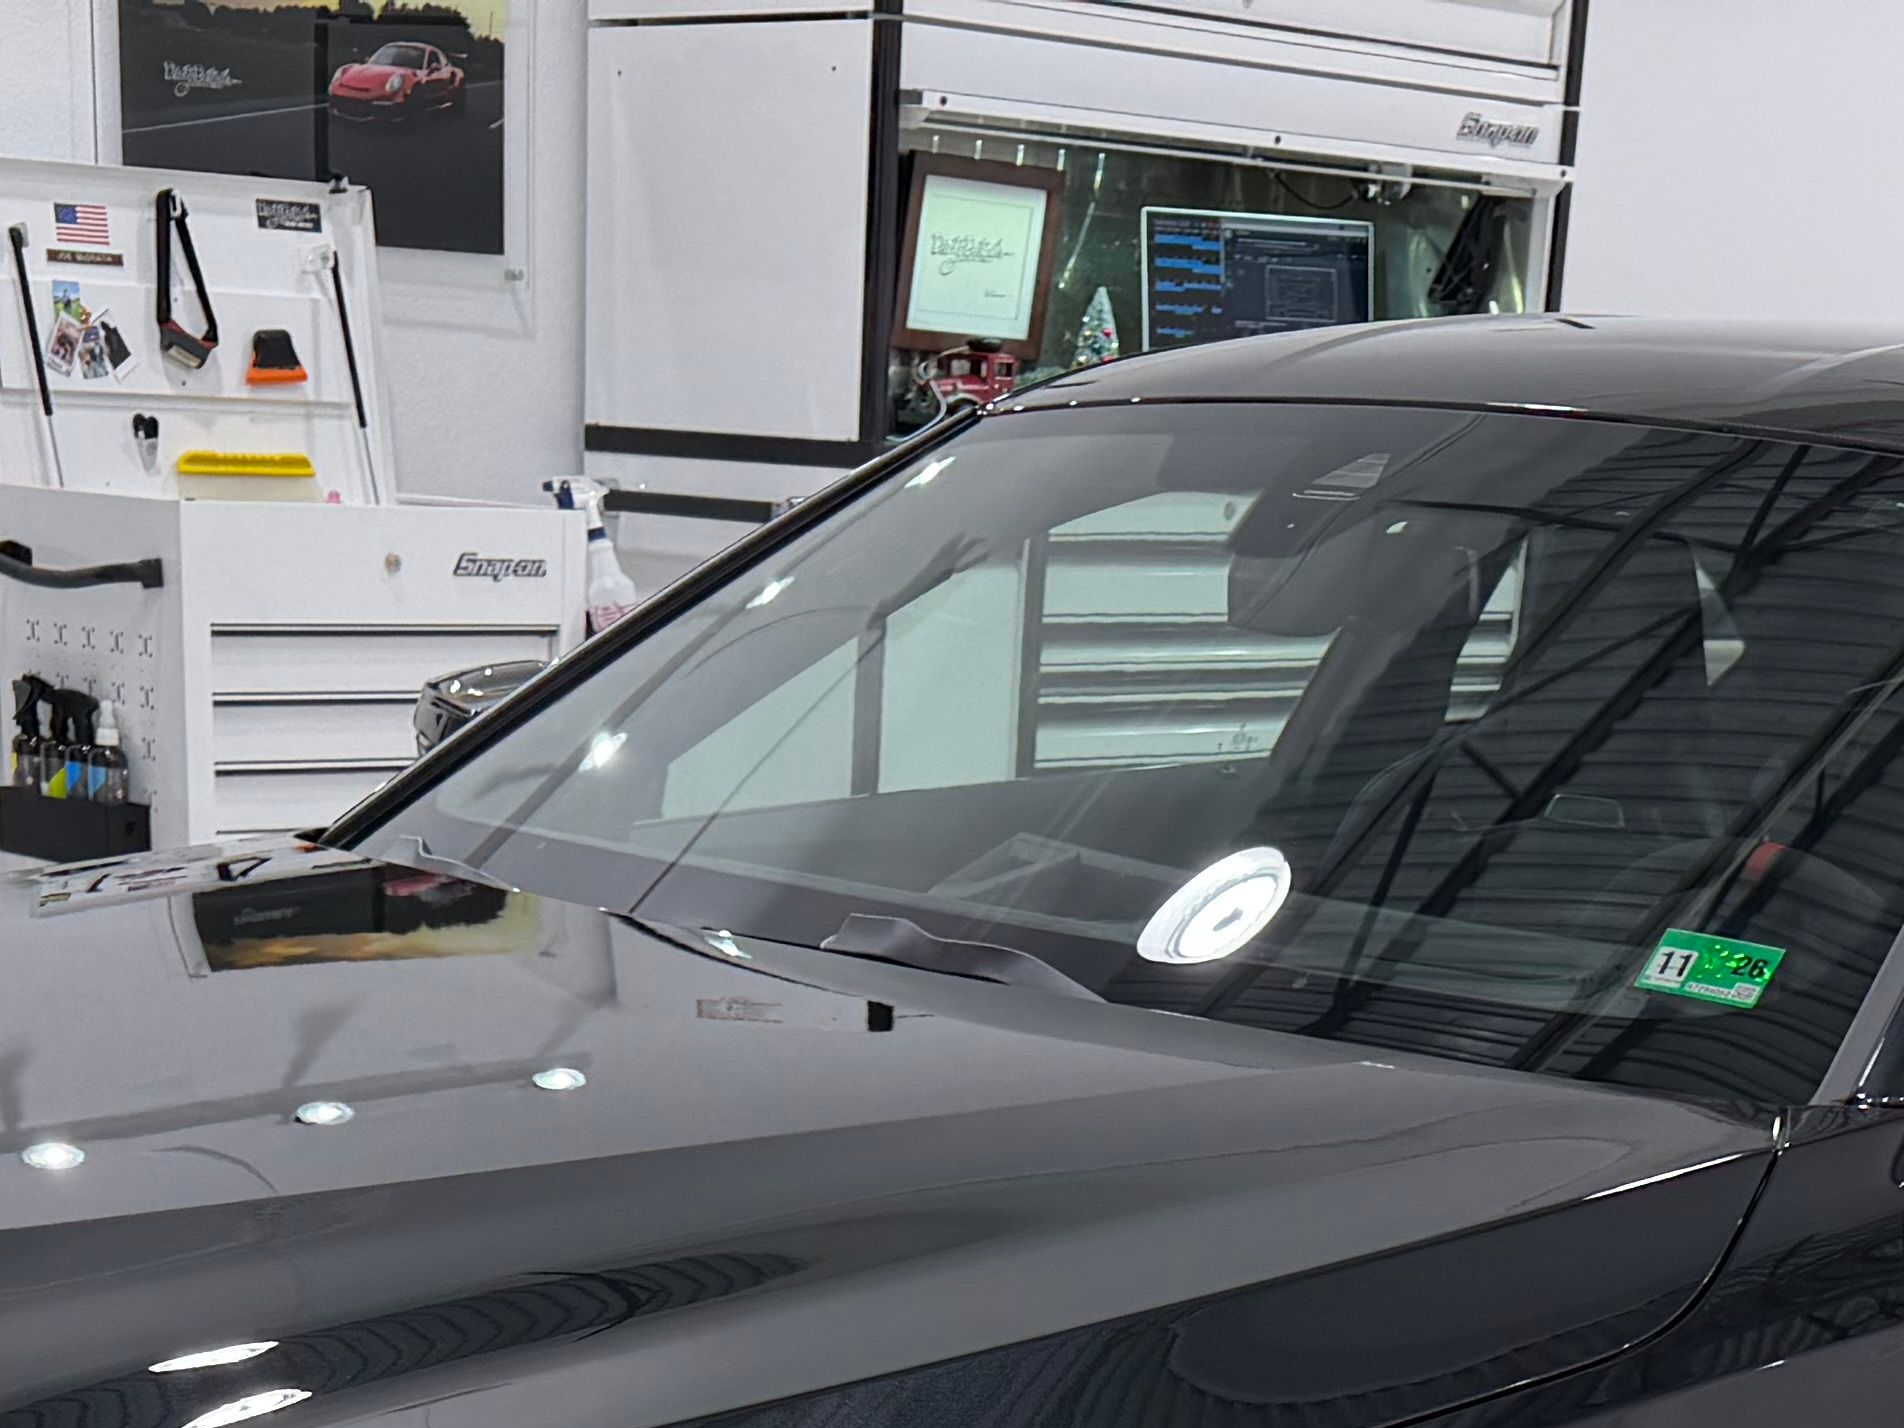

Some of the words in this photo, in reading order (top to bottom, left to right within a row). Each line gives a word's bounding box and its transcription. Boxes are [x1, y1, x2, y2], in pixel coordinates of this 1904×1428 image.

[453, 552, 547, 582] Snap-on
[1659, 951, 1693, 978] 11
[1730, 955, 1769, 979] 26
